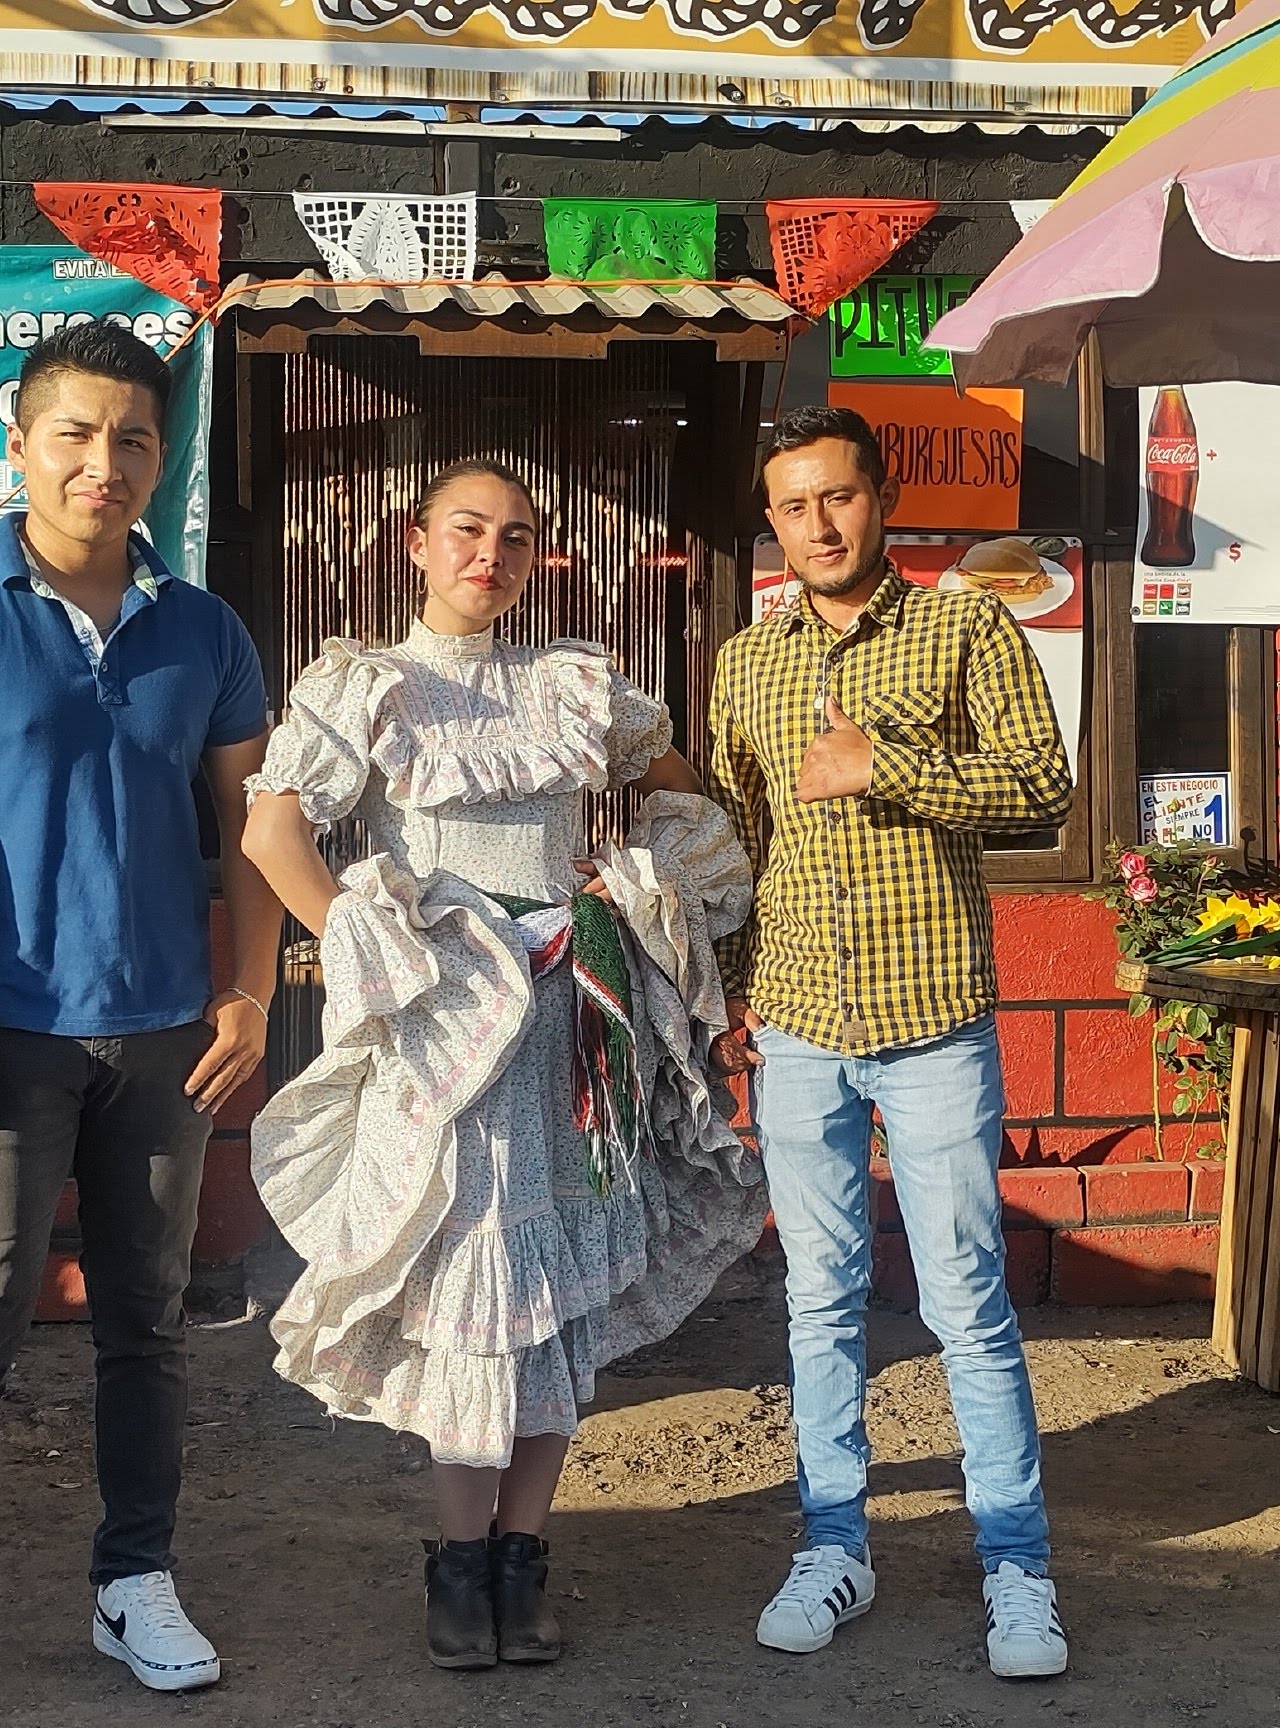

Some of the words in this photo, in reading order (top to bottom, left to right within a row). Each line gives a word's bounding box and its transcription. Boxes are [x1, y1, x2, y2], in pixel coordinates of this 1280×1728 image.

[54, 259, 107, 279] EVITA
[874, 423, 1019, 489] BURGUESAS
[1142, 782, 1154, 792] EN
[1156, 782, 1177, 792] ESTE
[1180, 780, 1218, 791] NEGOCIO
[1144, 795, 1162, 808] EL
[1166, 808, 1200, 824] SIEMPRE
[1204, 795, 1223, 843] 1
